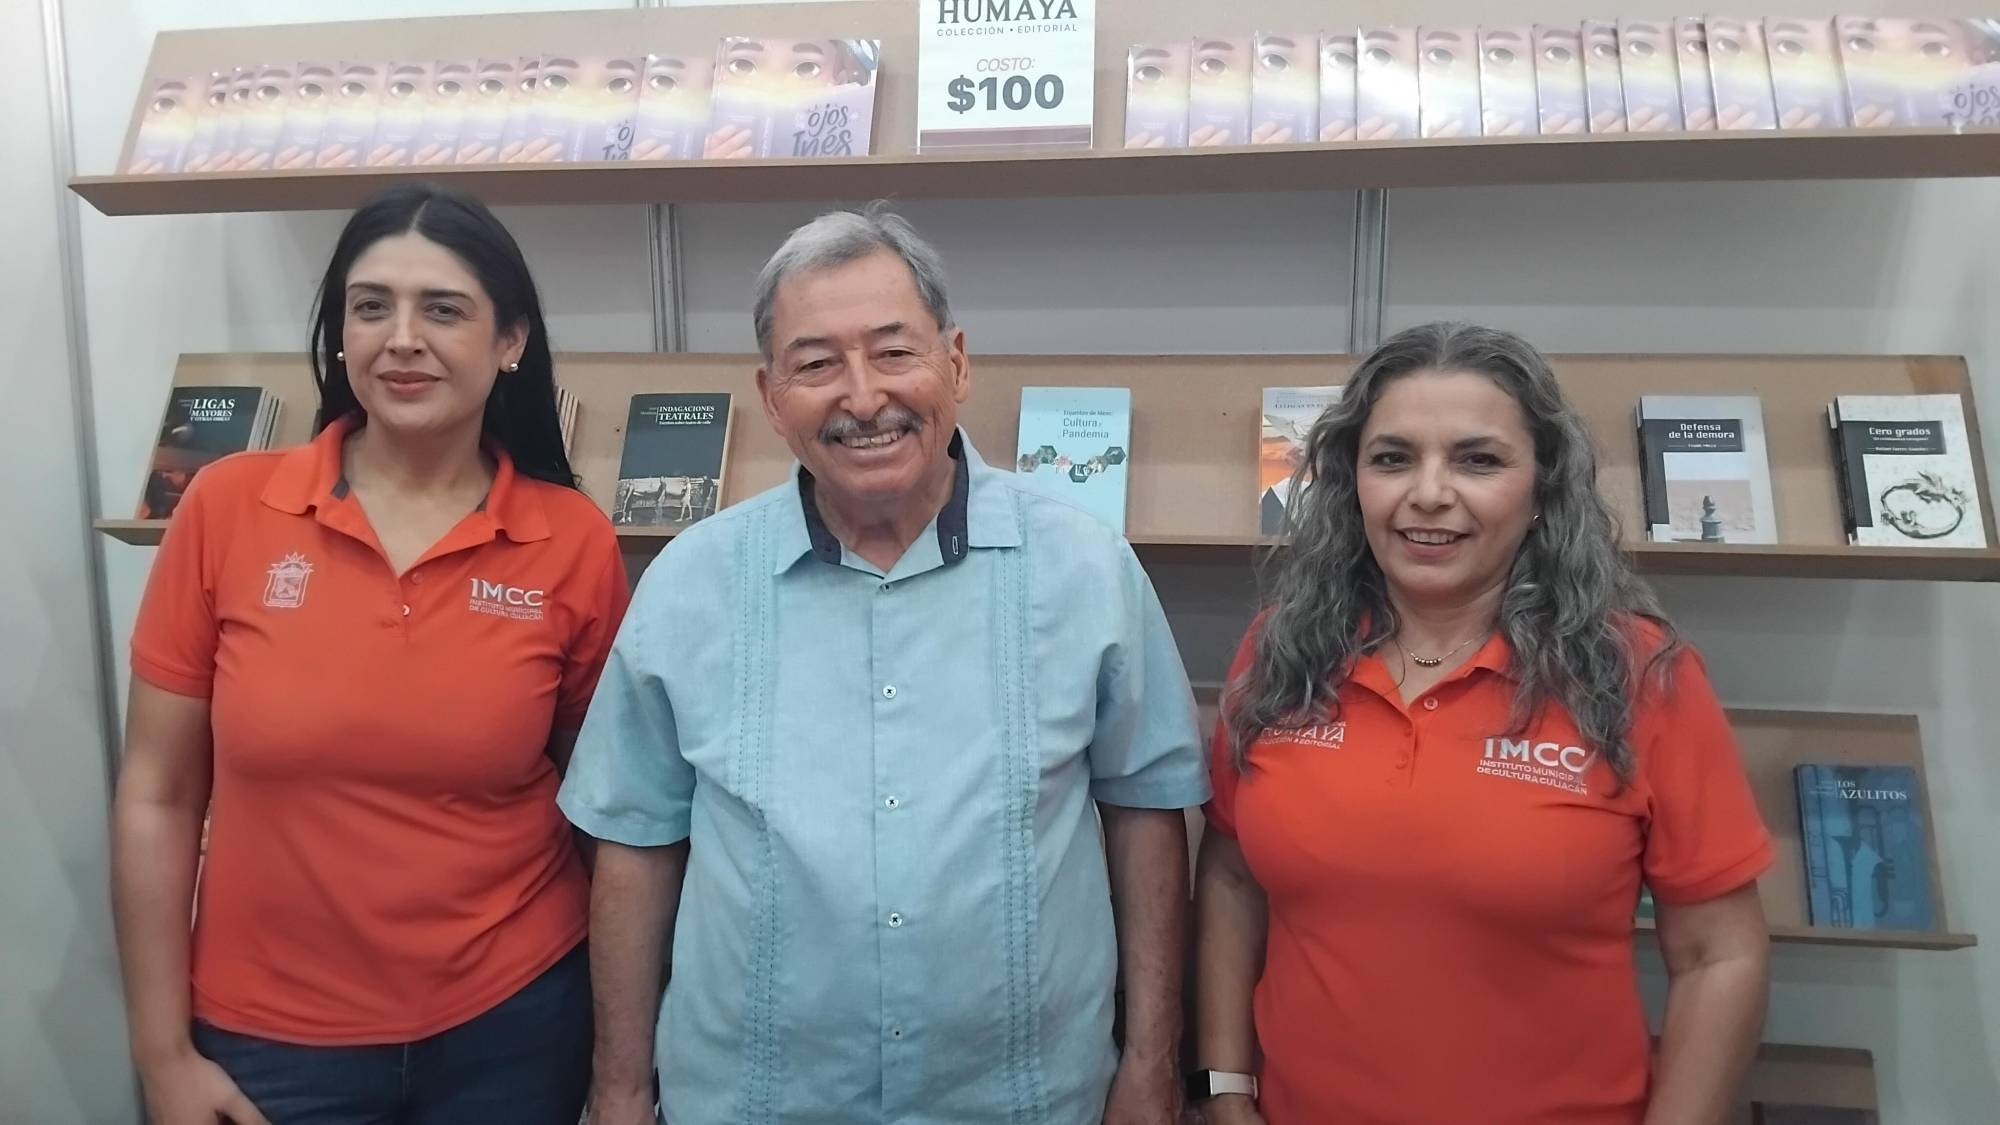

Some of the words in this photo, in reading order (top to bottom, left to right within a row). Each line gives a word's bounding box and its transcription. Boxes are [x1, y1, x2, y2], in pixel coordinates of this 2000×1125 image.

[938, 0, 1077, 24] HUMAYA
[937, 26, 1004, 37] COLECCIÓN
[1017, 24, 1078, 34] EDITORIAL
[976, 57, 1036, 72] COSTO:
[947, 74, 1064, 115] $100
[808, 104, 849, 137] ojos
[792, 126, 854, 156] Inés
[193, 398, 236, 409] LIGAS
[658, 412, 714, 420] TEATRALES
[1063, 417, 1098, 427] Cultura
[1680, 423, 1721, 431] Defensa
[1869, 427, 1892, 435] Cero
[1895, 427, 1931, 437] grados
[1062, 429, 1109, 438] Pandemia
[1696, 431, 1735, 439] demora
[470, 577, 544, 606] IMCC
[1483, 737, 1586, 773] IMCC
[1480, 759, 1532, 773] INSTITUTO
[1838, 780, 1856, 788] LOS
[1840, 789, 1908, 800] AZULITOS
